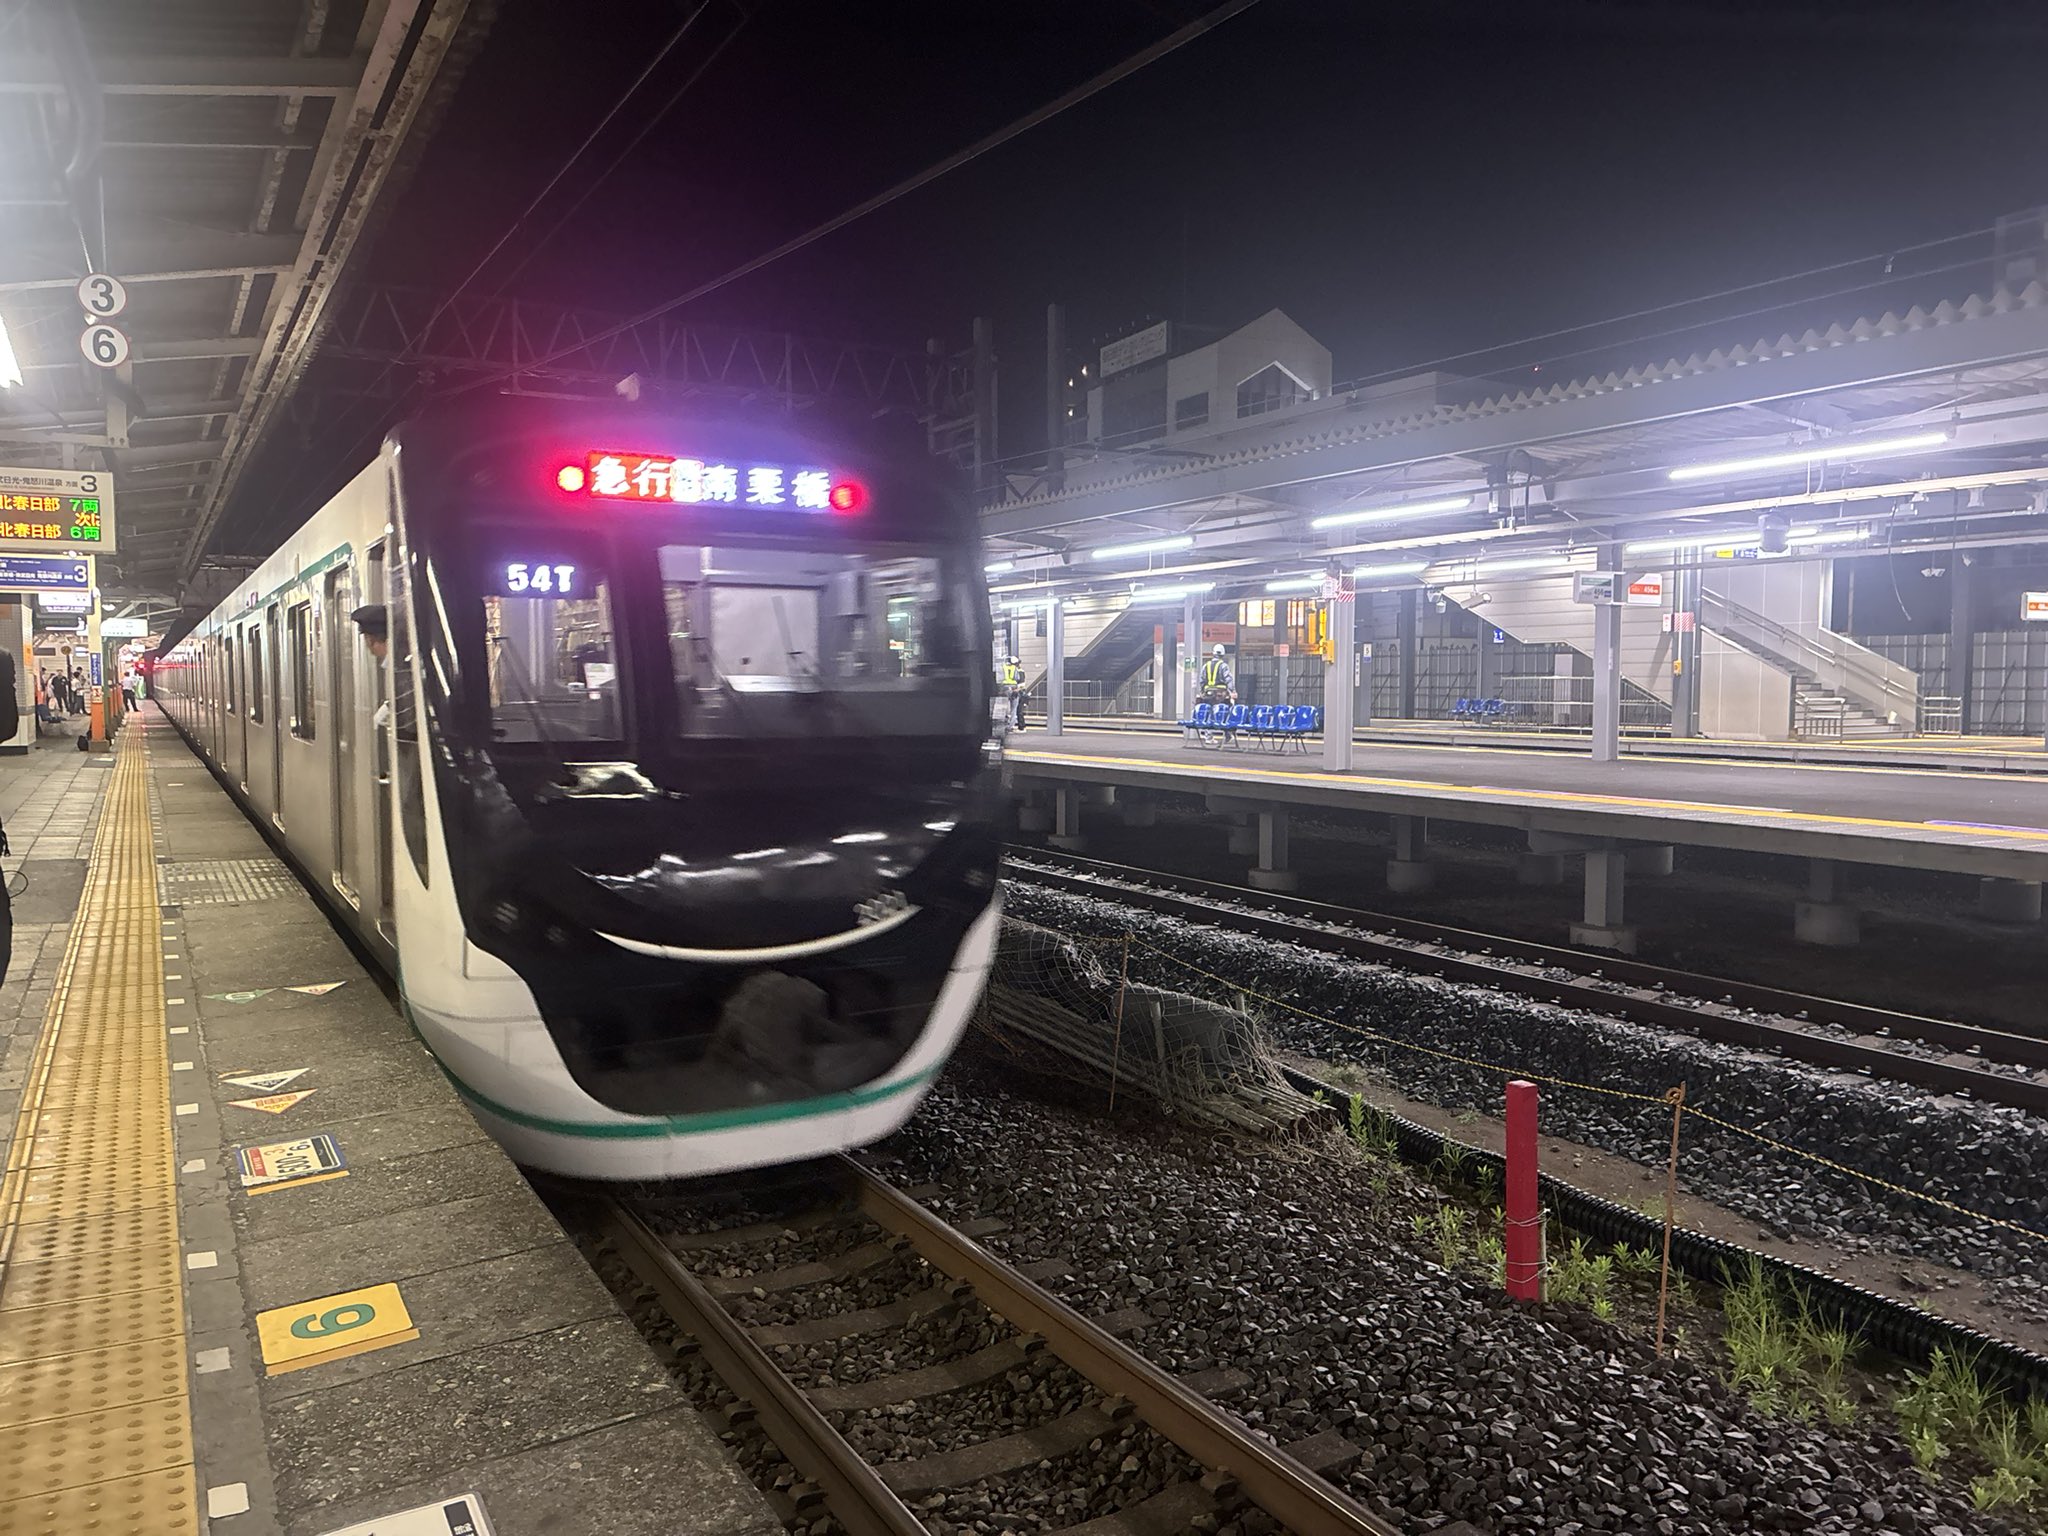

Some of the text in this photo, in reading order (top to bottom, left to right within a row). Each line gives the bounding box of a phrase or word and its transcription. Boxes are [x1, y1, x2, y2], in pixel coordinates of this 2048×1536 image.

[91, 278, 115, 312] 3
[92, 328, 117, 363] 6
[80, 474, 98, 493] 3
[591, 456, 672, 497] 急行
[0, 495, 99, 514] 北春日部 7両
[0, 522, 100, 540] 北春日部 6両
[73, 565, 87, 583] 3
[507, 563, 575, 593] 54T
